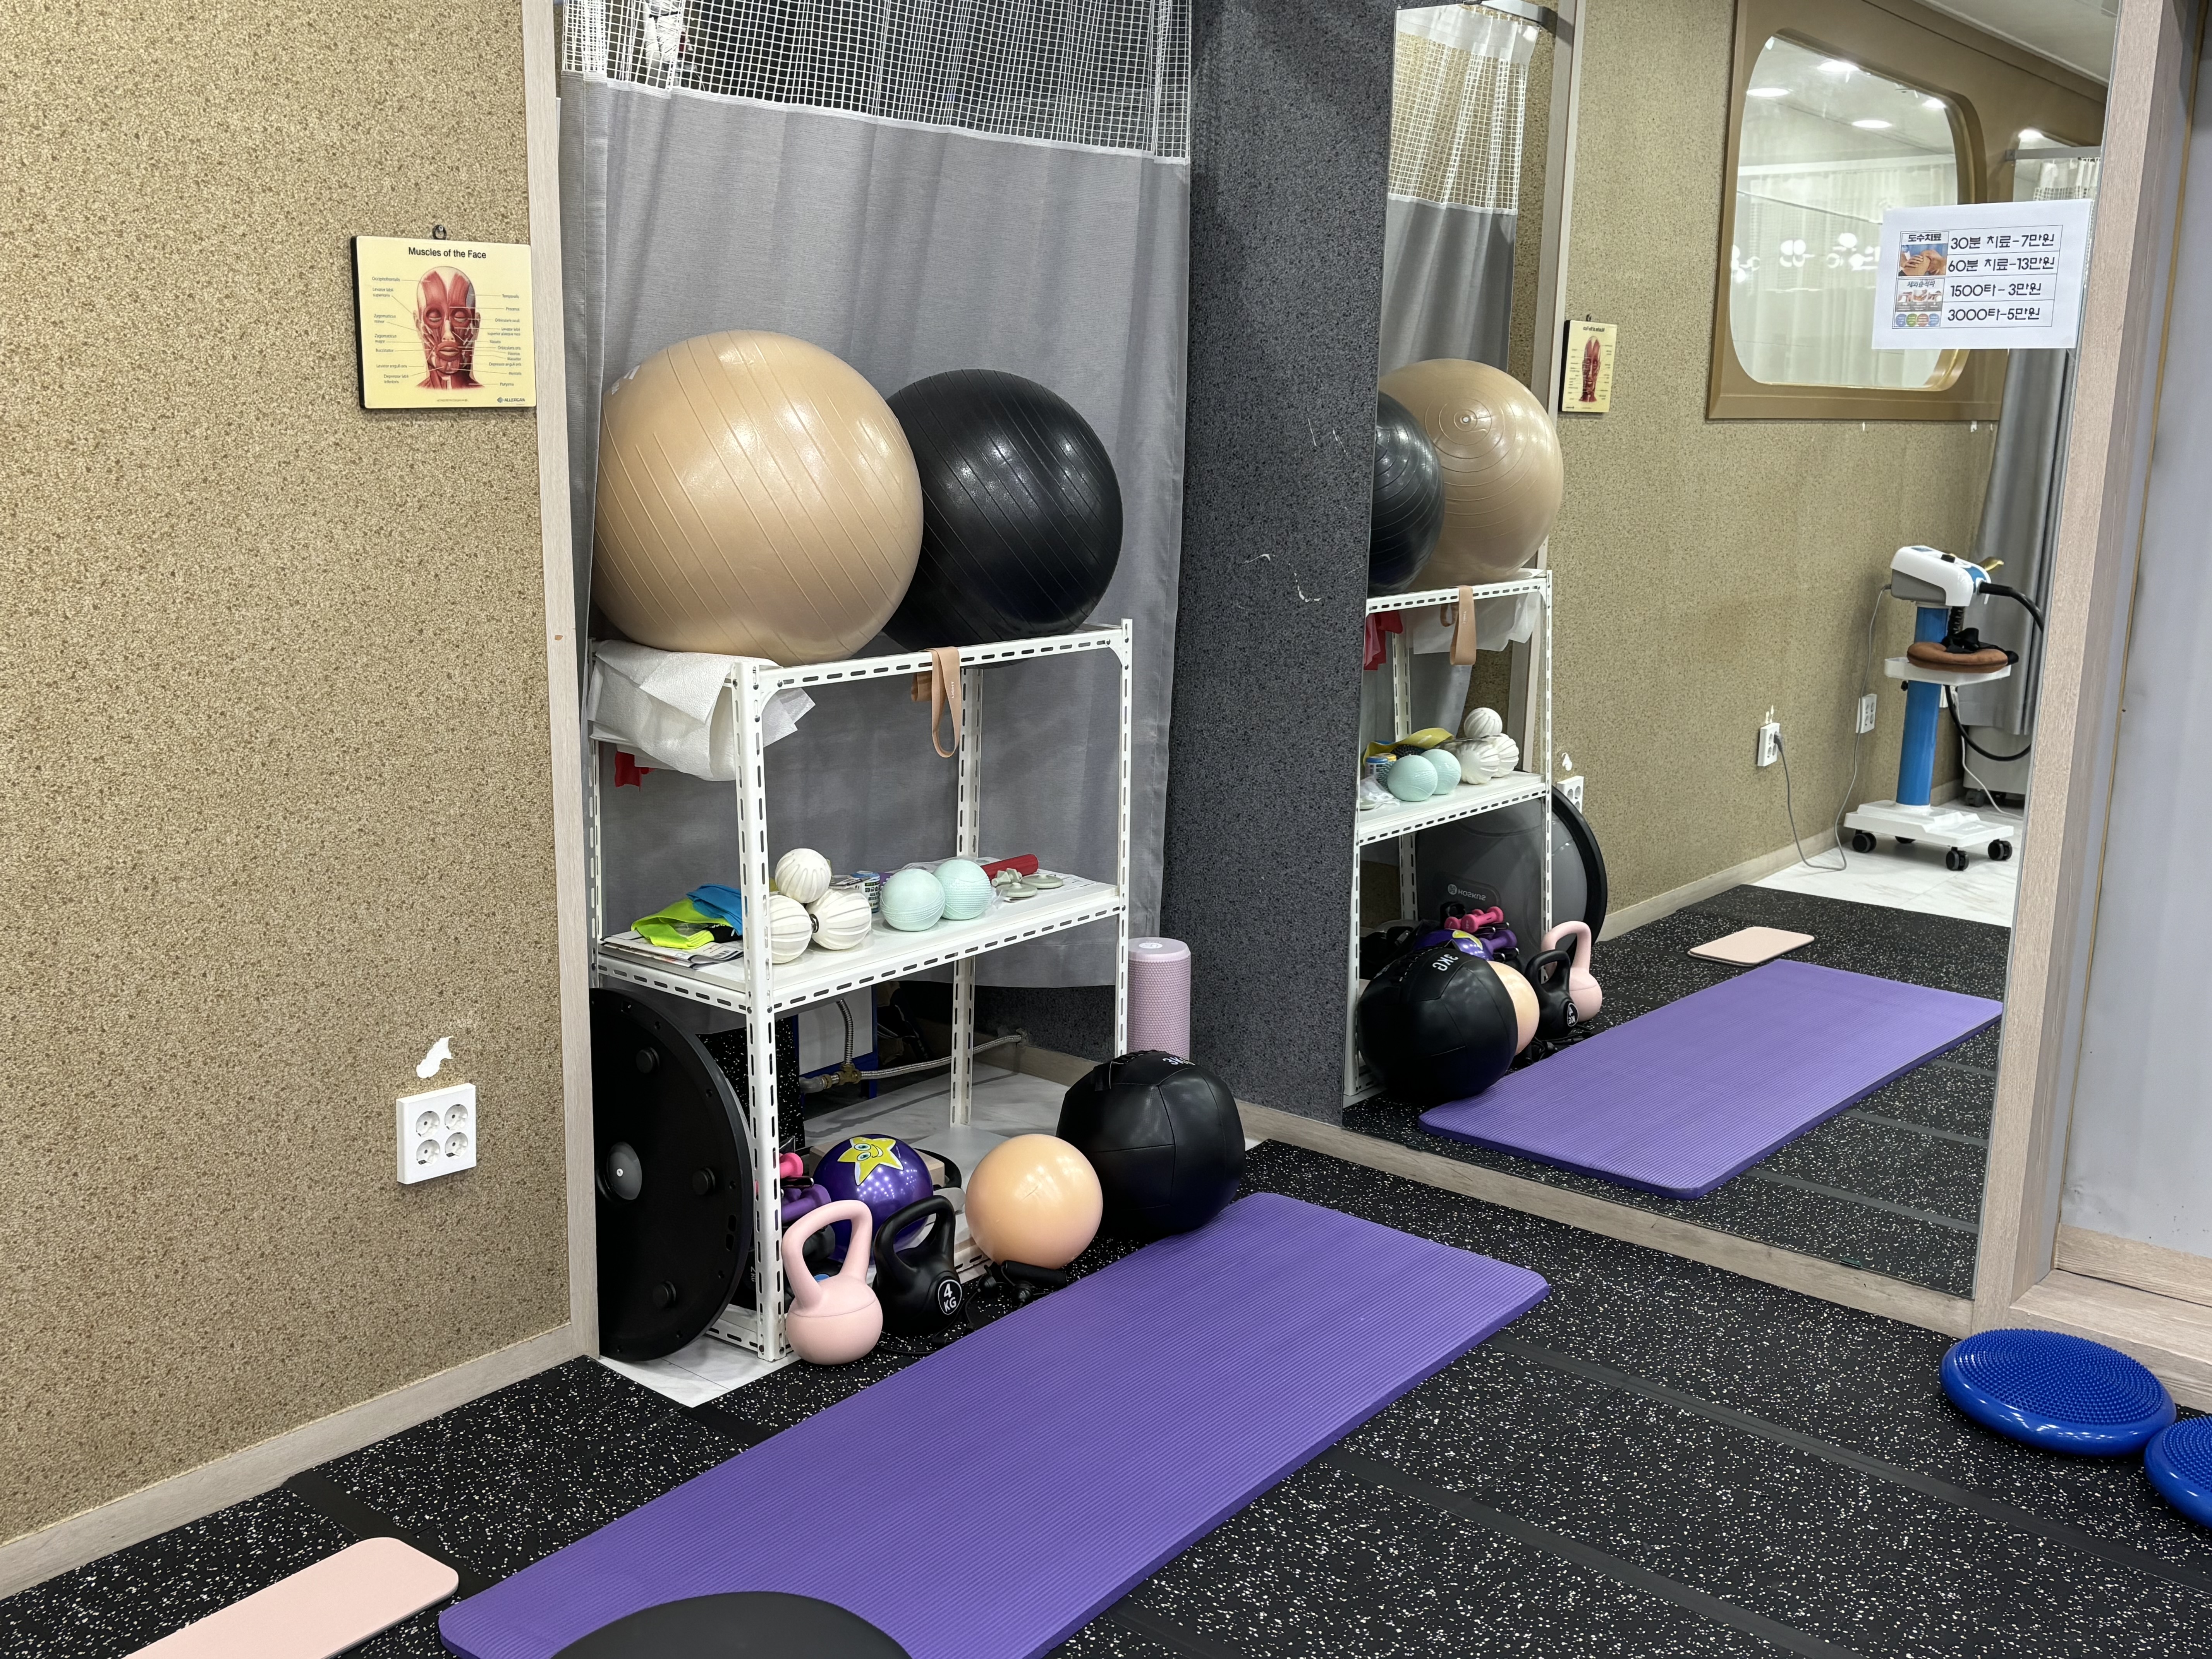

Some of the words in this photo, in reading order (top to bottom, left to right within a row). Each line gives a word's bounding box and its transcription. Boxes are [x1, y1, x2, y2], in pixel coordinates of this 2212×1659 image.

[1908, 233, 1942, 242] 도수치료
[1951, 237, 1981, 249] 30분
[1987, 234, 2055, 248] 치료-7만원
[409, 247, 441, 256] Muscles
[453, 249, 465, 258] the
[468, 250, 486, 259] Face
[1948, 259, 1978, 272] 60분
[1984, 256, 2055, 271] 치료-13만원
[2008, 282, 2042, 295] 3만원
[943, 1283, 953, 1298] 4
[944, 1297, 957, 1312] KG
